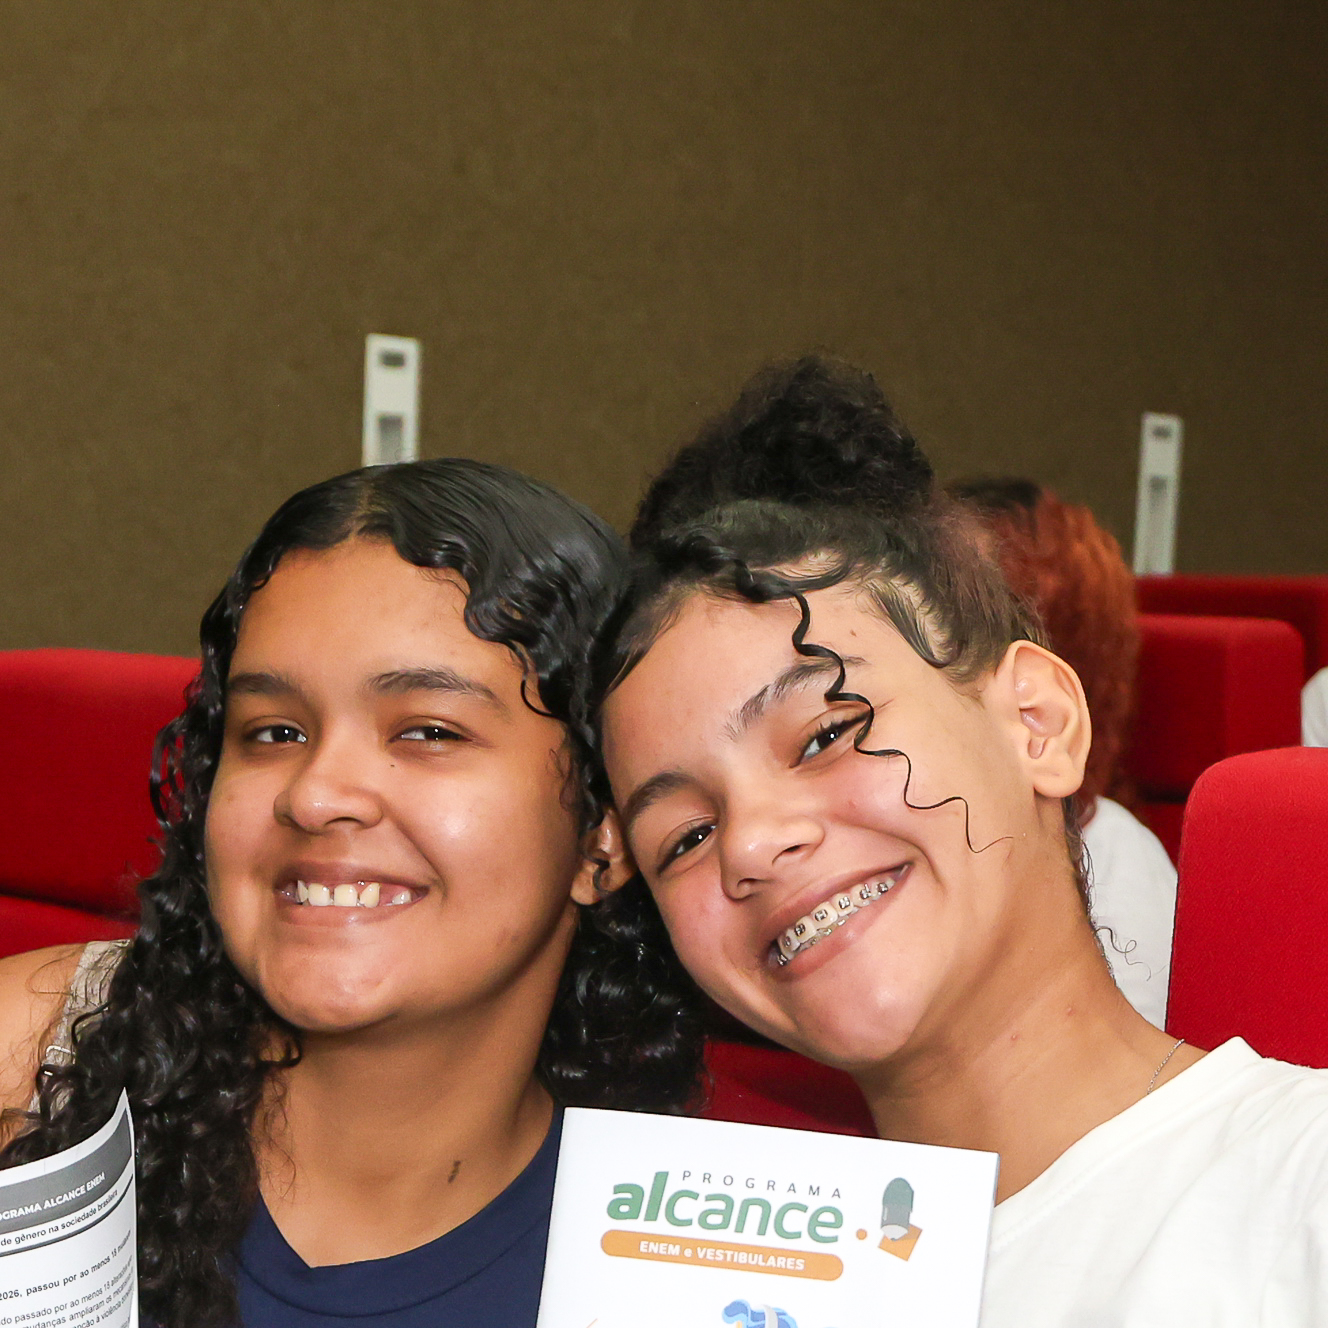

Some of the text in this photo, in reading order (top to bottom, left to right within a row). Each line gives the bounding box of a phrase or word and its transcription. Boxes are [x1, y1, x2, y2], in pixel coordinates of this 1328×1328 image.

[43, 1185, 86, 1210] ALCANCE
[86, 1171, 105, 1192] ENEM
[606, 1170, 844, 1243] PROGRAMA alcance
[0, 1238, 12, 1246] de
[14, 1229, 47, 1244] gênero
[61, 1207, 97, 1230] sociedade
[639, 1240, 806, 1271] ENEM e VESTIBULARES
[26, 1280, 60, 1296] passou
[63, 1274, 77, 1286] por
[80, 1269, 89, 1278] ao
[91, 1255, 110, 1273] menos
[14, 1307, 52, 1324] passado
[54, 1302, 68, 1314] por
[70, 1299, 80, 1308] ao
[81, 1286, 103, 1303] menos
